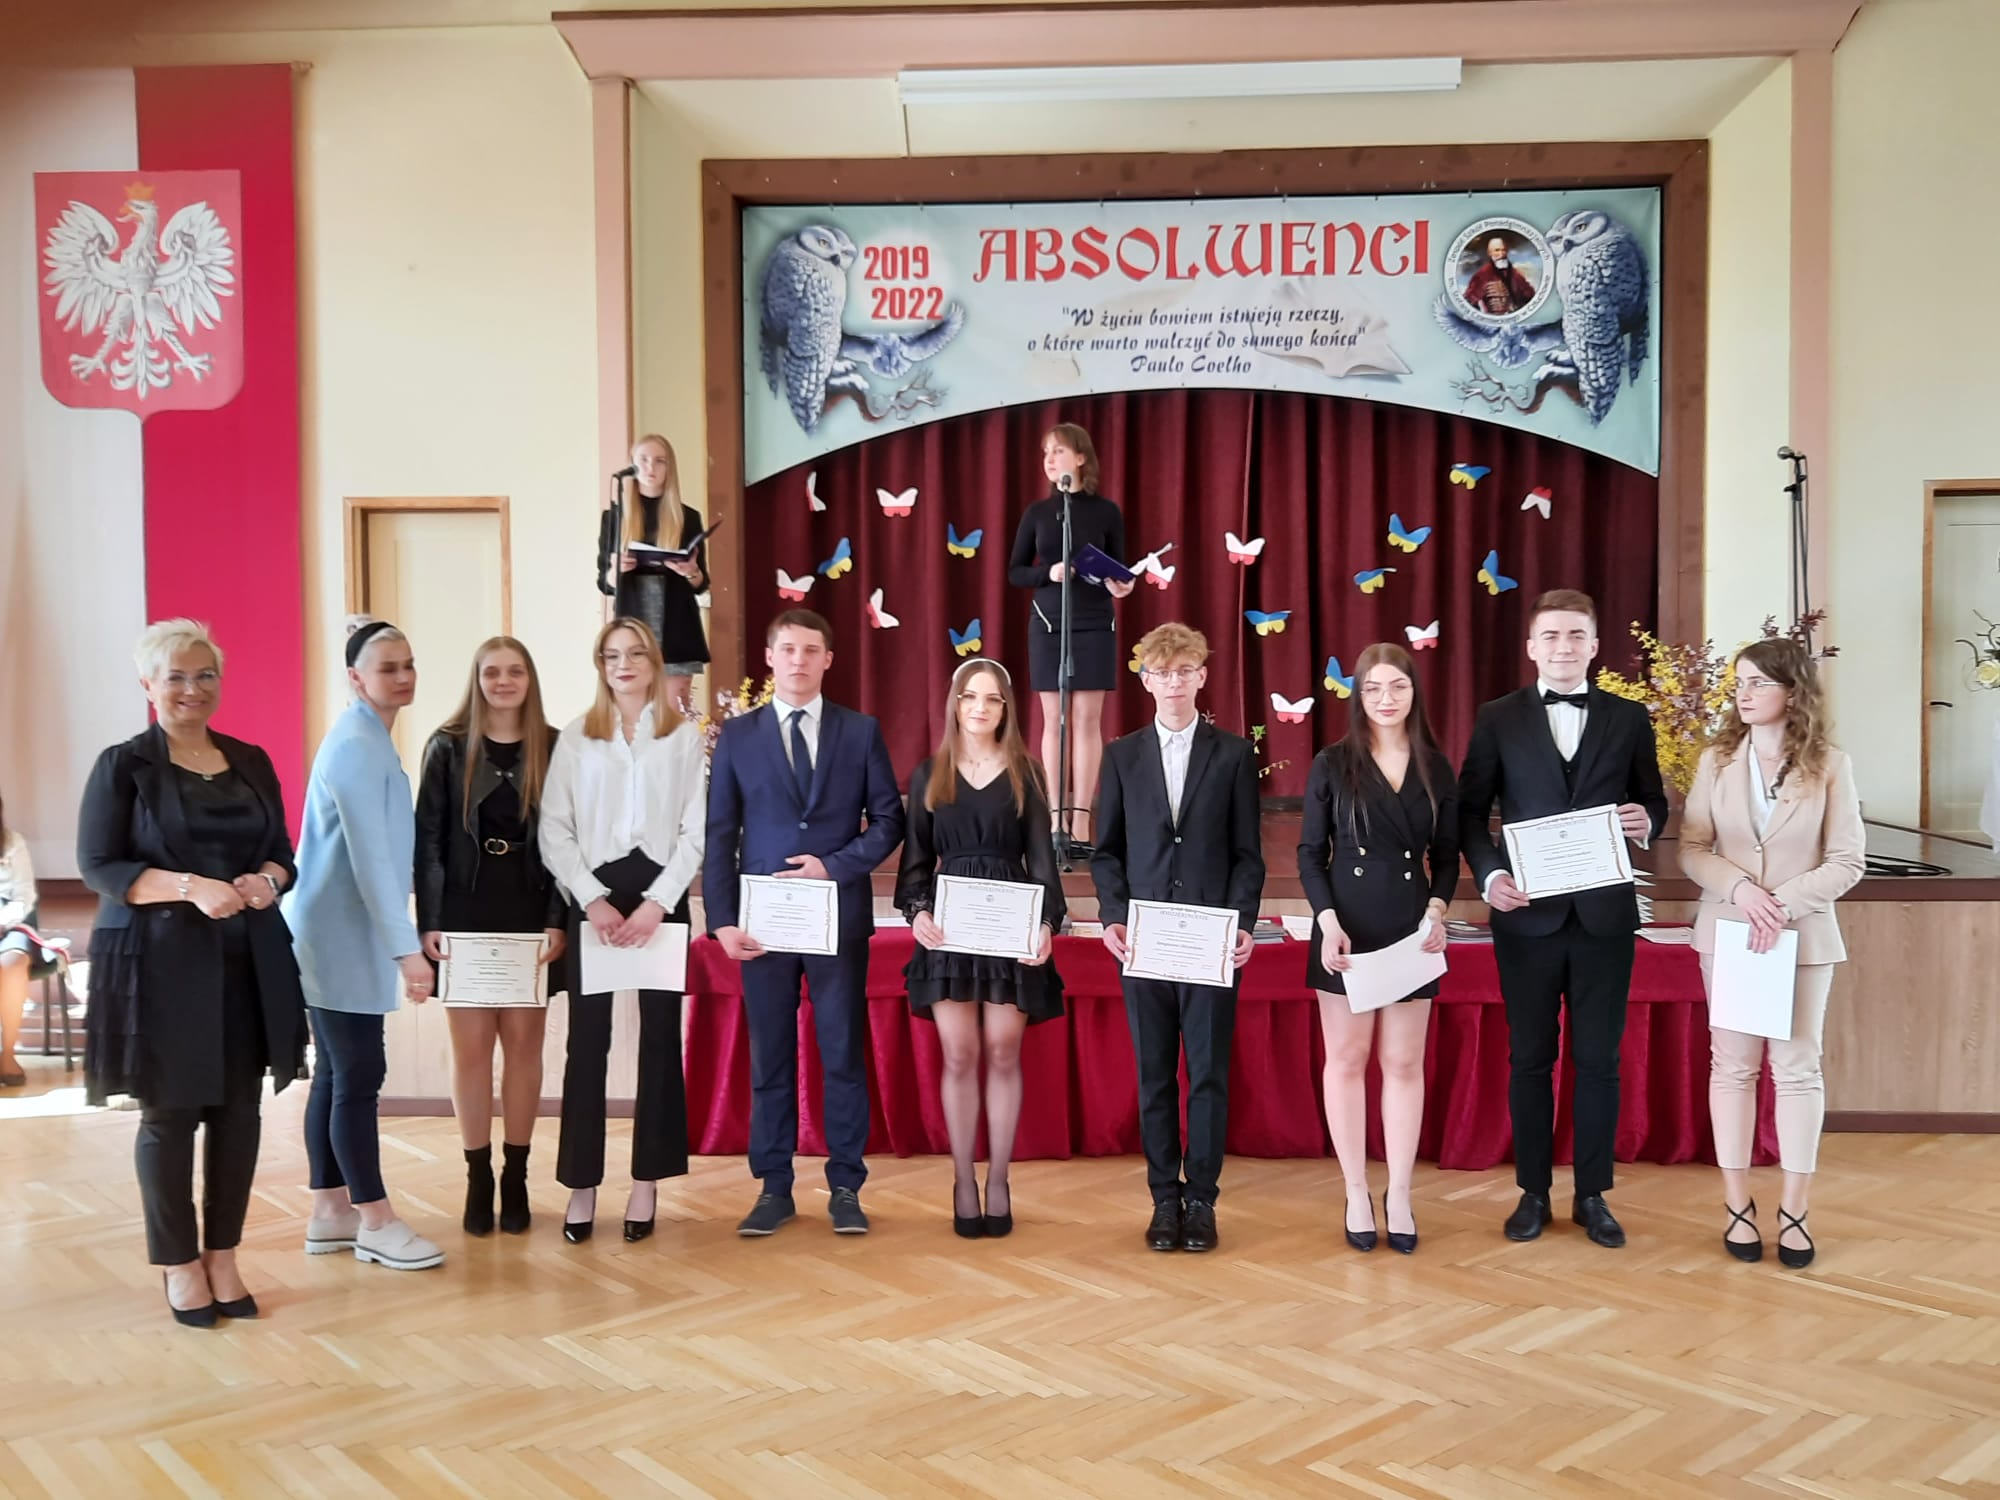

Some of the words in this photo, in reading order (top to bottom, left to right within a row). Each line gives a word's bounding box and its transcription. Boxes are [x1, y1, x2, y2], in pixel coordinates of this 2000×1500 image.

[864, 246, 928, 280] 2019
[973, 220, 1429, 282] ABSOLWENCI
[871, 286, 944, 320] 2022
[1100, 310, 1143, 331] życiu
[1149, 307, 1213, 326] bowiem
[1219, 305, 1282, 328] istnieją
[1027, 340, 1037, 351] o
[1043, 334, 1084, 351] które
[1090, 336, 1138, 351] warto
[1144, 332, 1213, 353] walczyć
[1216, 331, 1236, 348] do
[1241, 336, 1303, 351] samego
[1130, 355, 1184, 373] Paulo
[1191, 354, 1252, 373] Coelho
